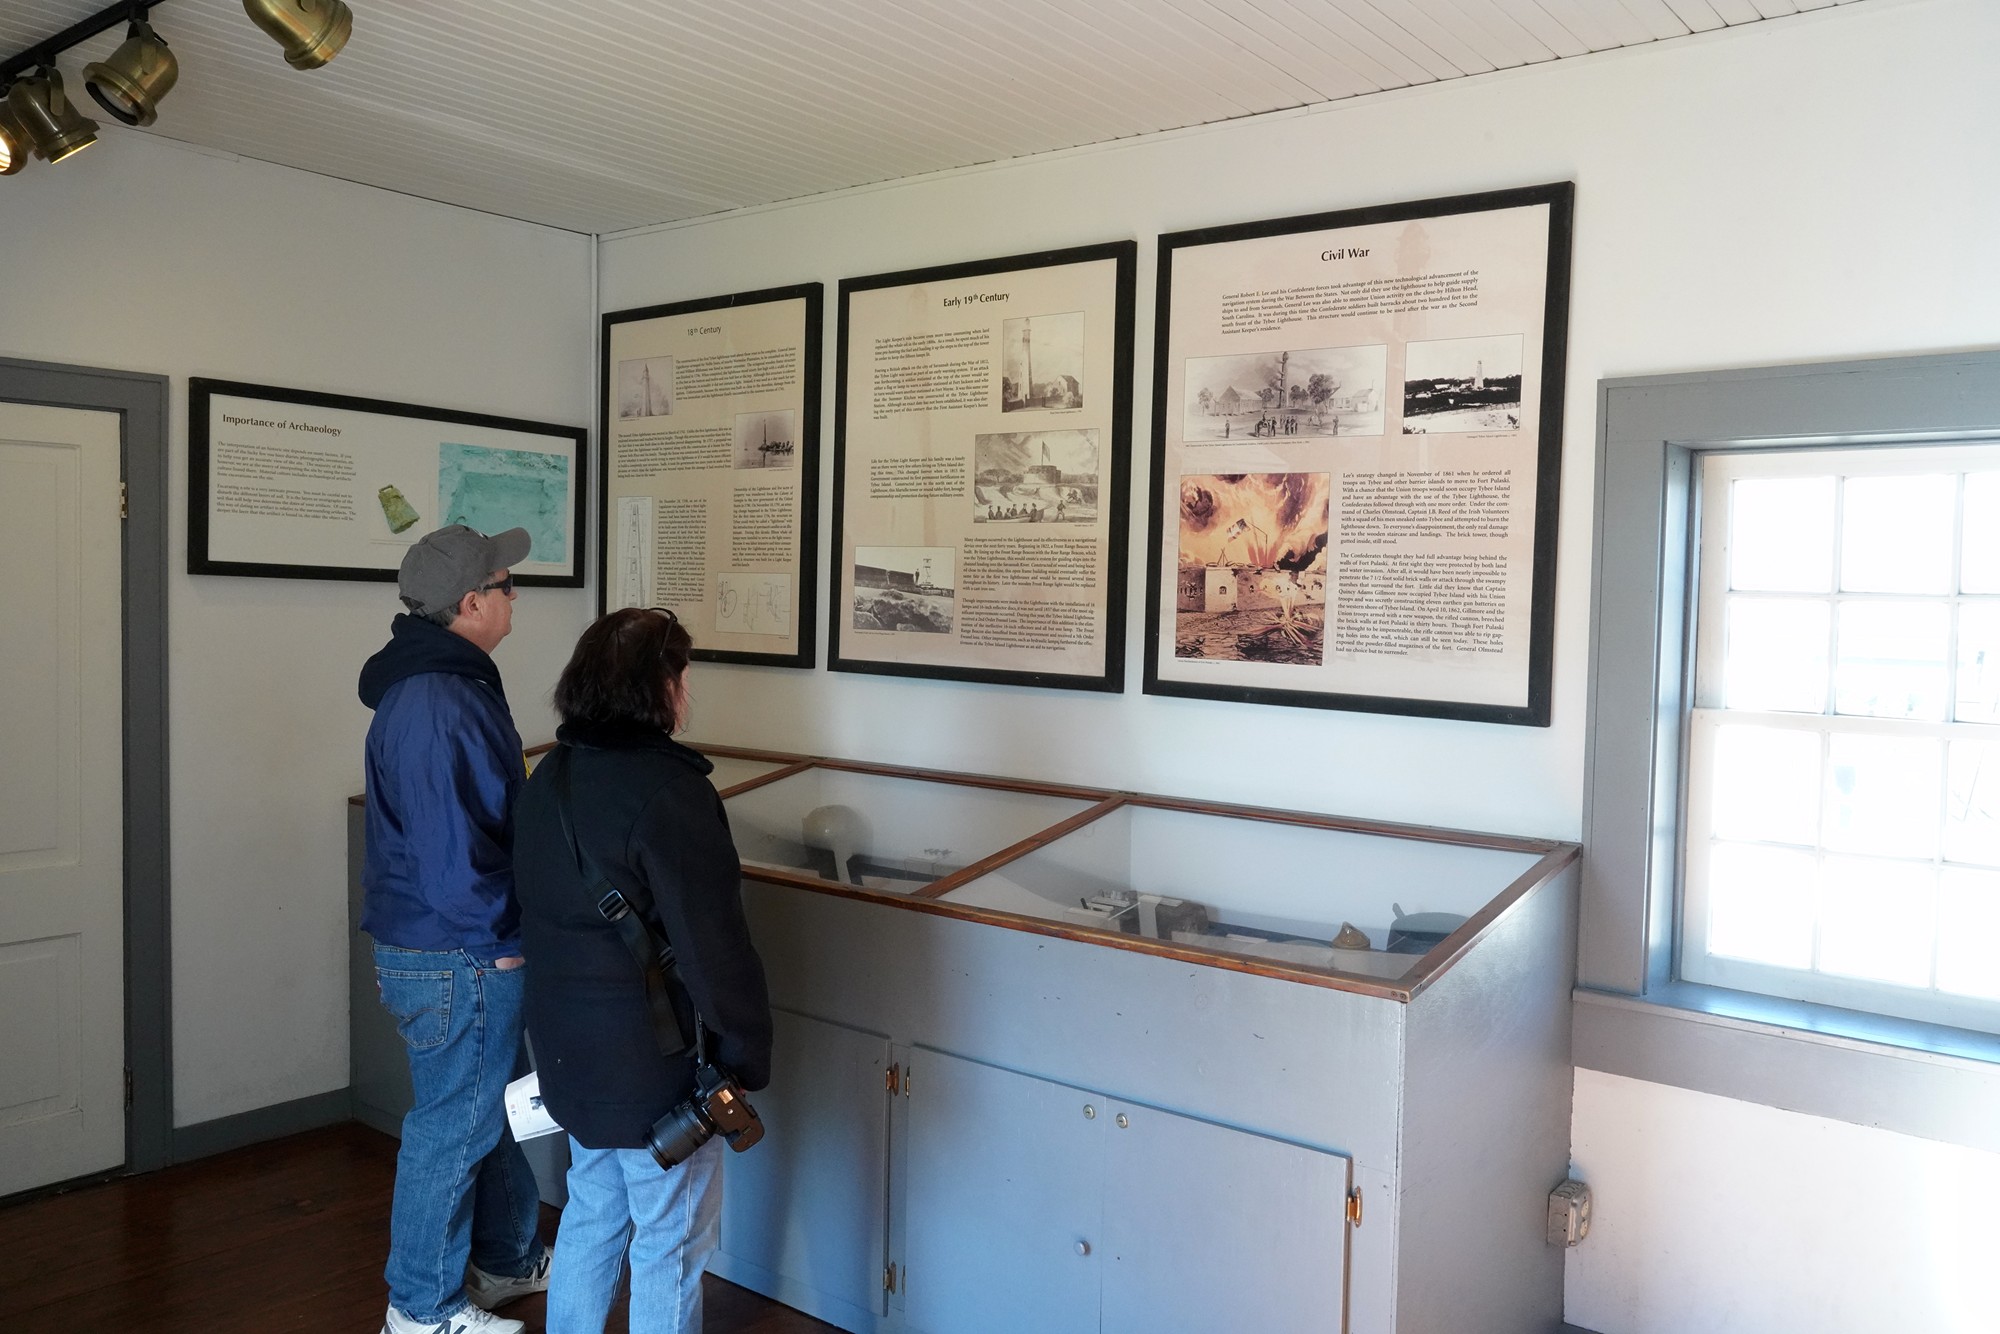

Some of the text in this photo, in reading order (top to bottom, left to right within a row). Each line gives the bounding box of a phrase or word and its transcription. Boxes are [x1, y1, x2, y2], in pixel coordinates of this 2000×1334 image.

[1321, 247, 1370, 262] Civil War
[944, 292, 1010, 308] Early 19th Century
[699, 326, 722, 335] Century
[222, 414, 342, 437] Importance of Archaeology
